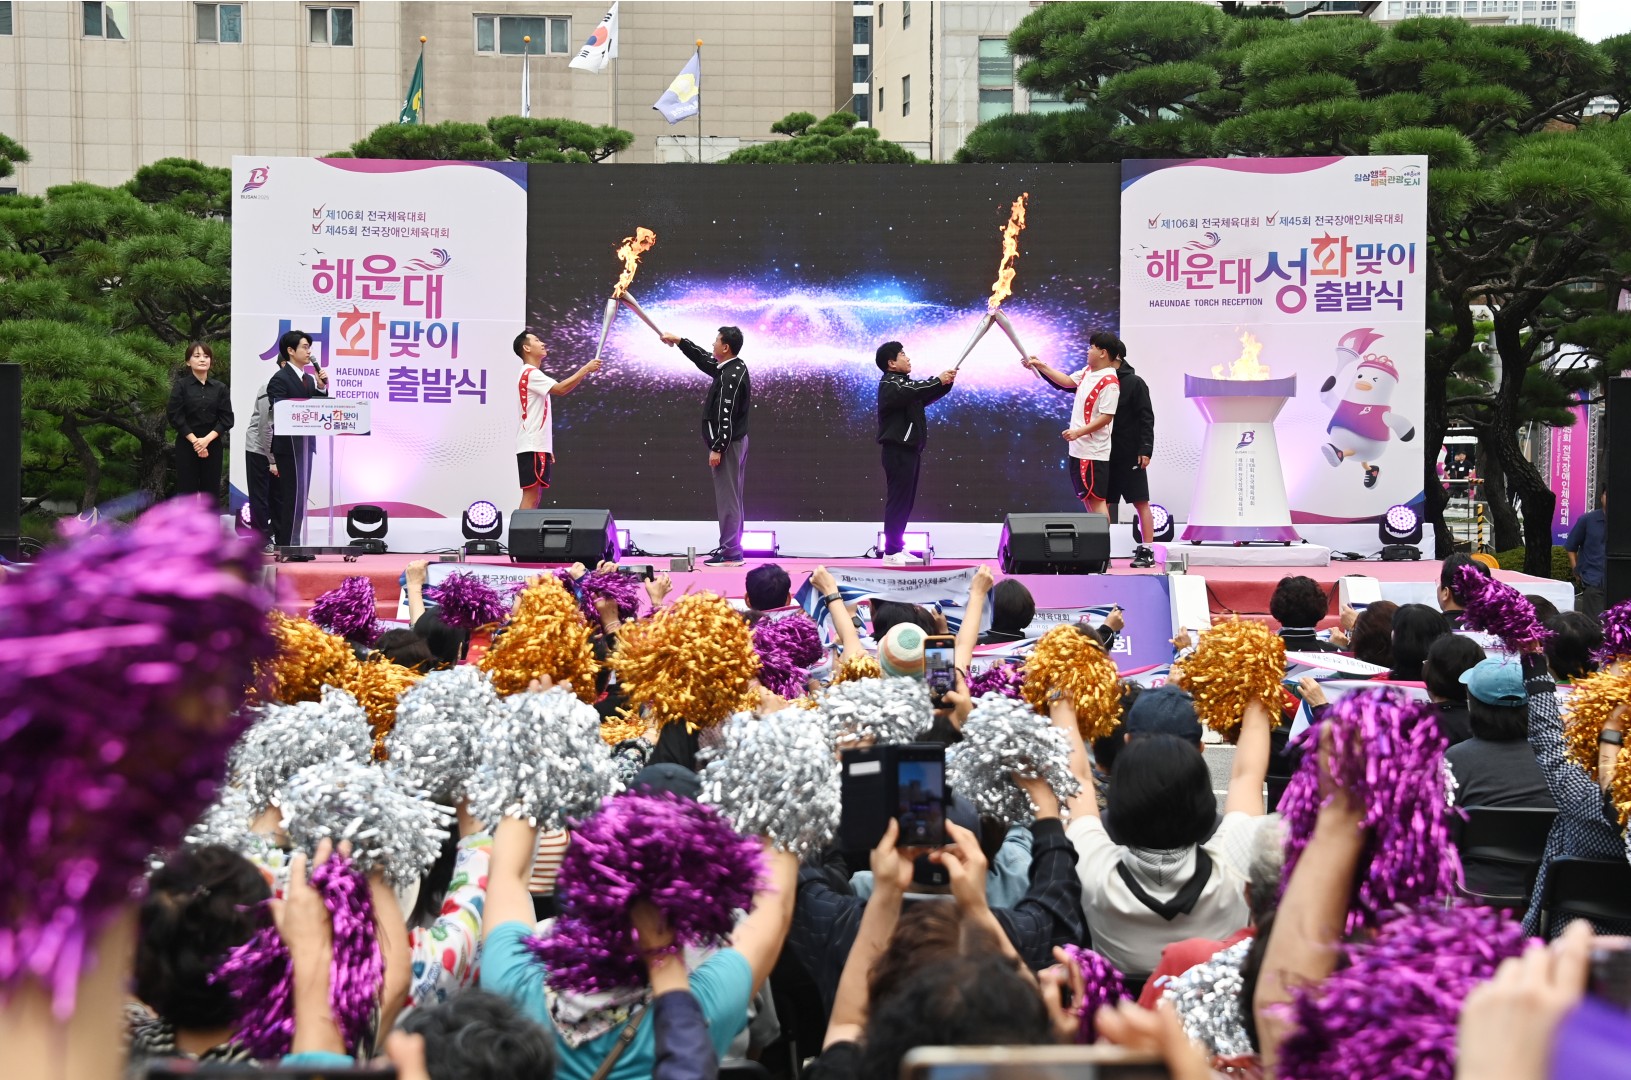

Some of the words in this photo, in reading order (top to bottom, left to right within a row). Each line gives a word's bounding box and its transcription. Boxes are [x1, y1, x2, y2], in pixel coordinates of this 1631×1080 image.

[325, 209, 364, 221] 제106회
[367, 210, 427, 223] 전국체육대회
[1160, 218, 1198, 229] 제106회
[1201, 216, 1260, 228] 전국체육대회
[1279, 214, 1311, 227] 제45회
[1314, 213, 1404, 226] 전국장애인체육대회
[325, 225, 358, 237] 제45회
[361, 226, 450, 238] 전국장애인체육대회
[1146, 249, 1252, 295] 해운대
[312, 254, 444, 319] 해운대
[1149, 299, 1190, 308] HAEUNDAE
[1194, 299, 1219, 307] TORCH
[1221, 298, 1263, 307] RECEPTION
[1314, 280, 1404, 312] 출발식
[336, 367, 380, 377] HAEUNDAE
[336, 379, 363, 388] TORCH
[387, 366, 487, 404] 출발식
[335, 390, 380, 400] RECEPTION
[291, 410, 319, 424] 해운대
[333, 421, 356, 430] 출발식
